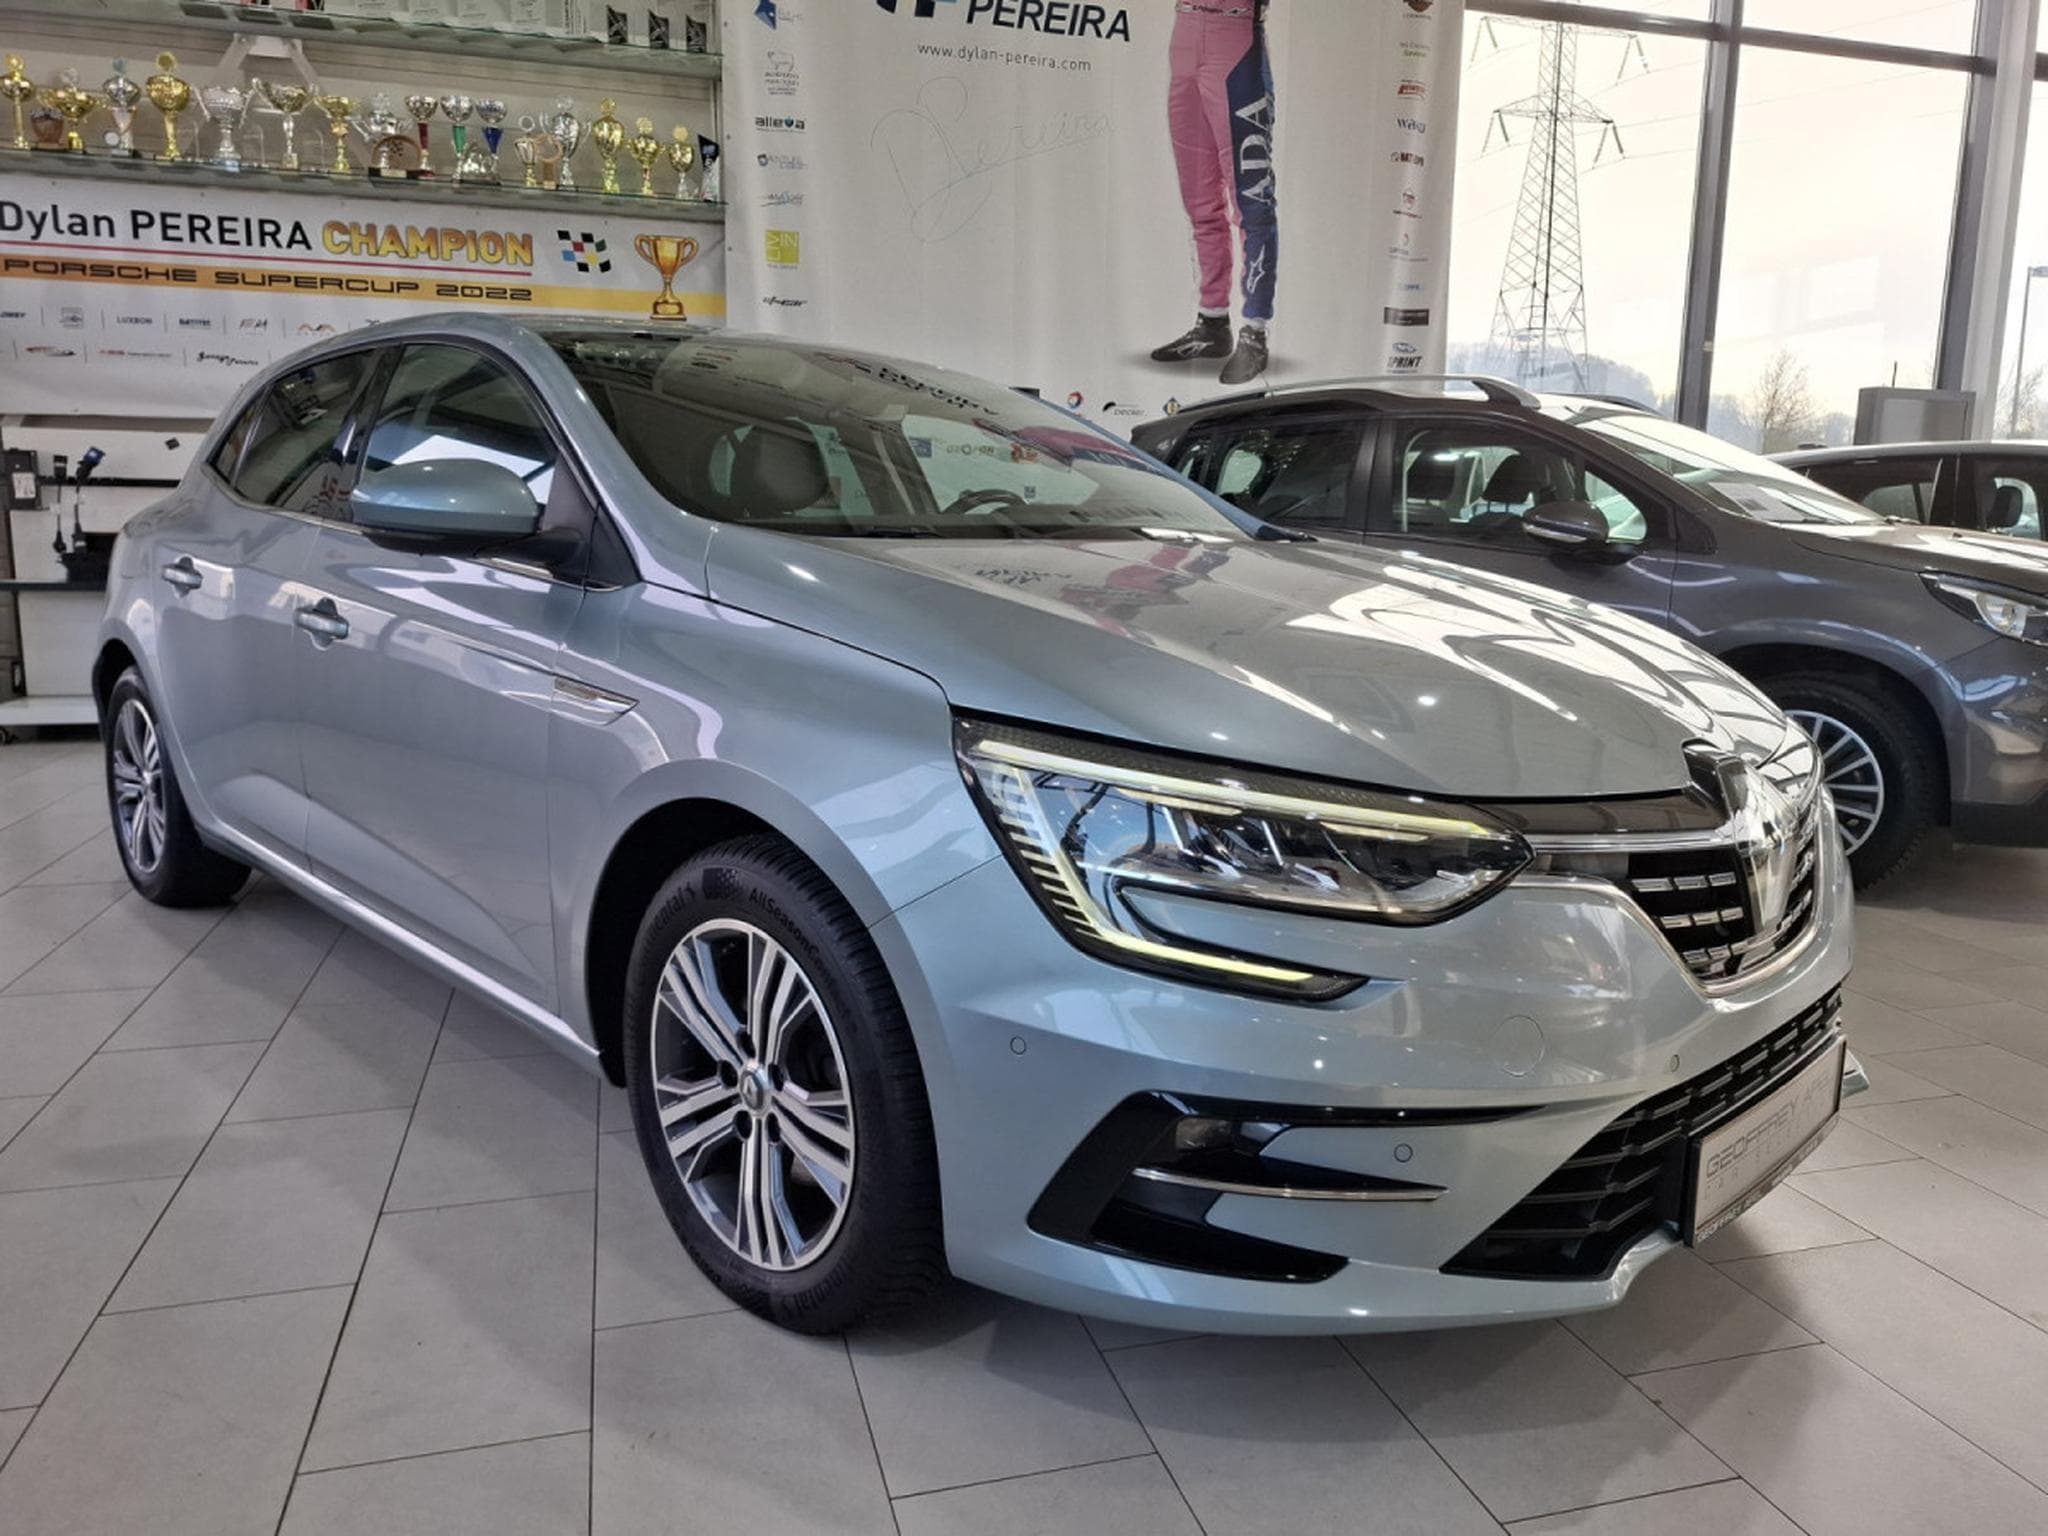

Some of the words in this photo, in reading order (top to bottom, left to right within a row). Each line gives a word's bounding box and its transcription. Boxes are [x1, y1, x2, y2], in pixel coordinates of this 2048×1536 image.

[966, 0, 1131, 42] PEREIRA
[917, 42, 1092, 72] www.dylan-pereira.com
[0, 201, 116, 240] Dylan
[130, 209, 312, 250] PEREIRA
[322, 219, 534, 267] CHAMPION
[4, 258, 198, 283] PORSCHE
[214, 271, 420, 293] SUPERCUP
[435, 283, 532, 301] 2022
